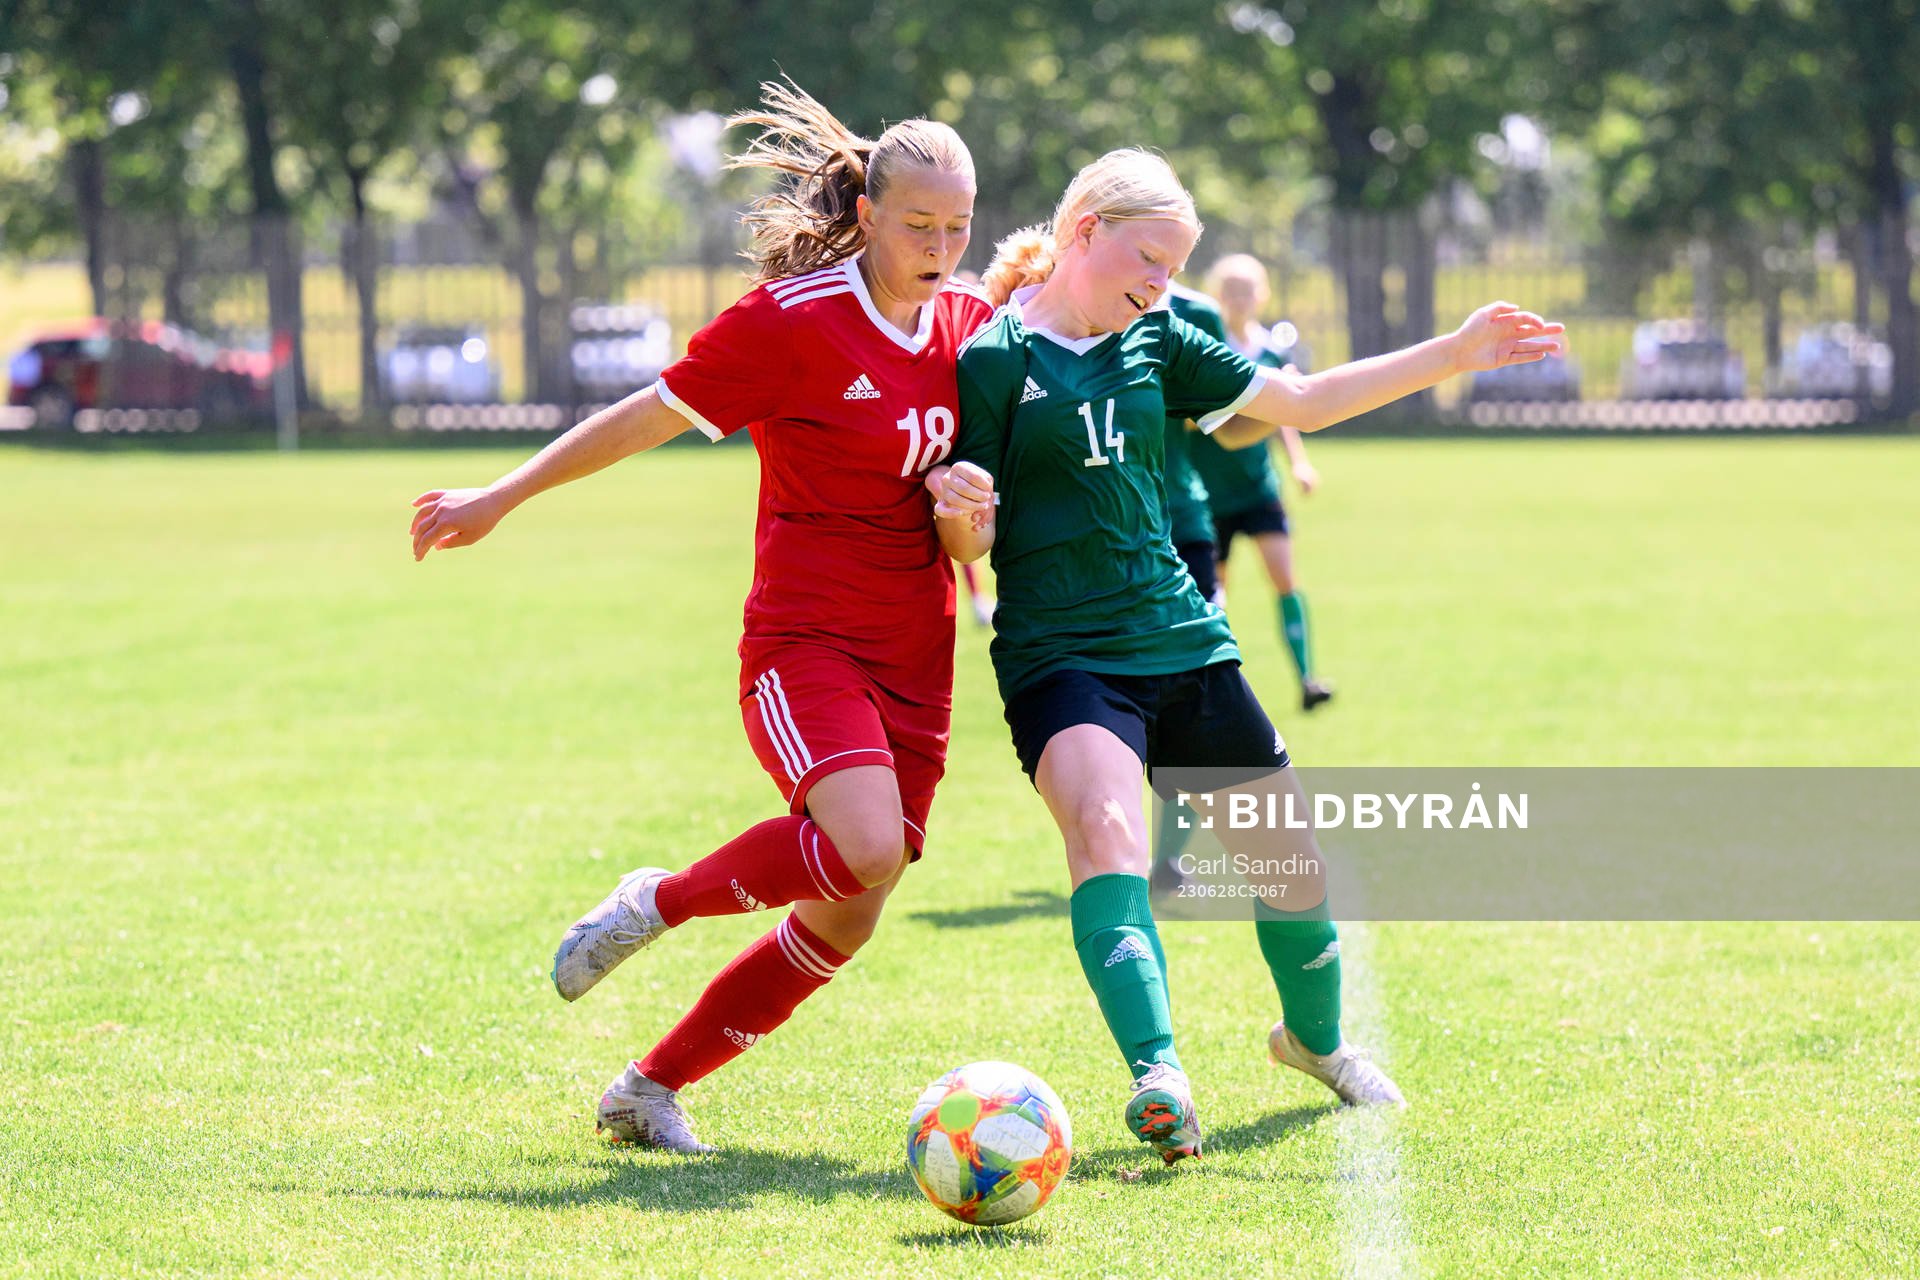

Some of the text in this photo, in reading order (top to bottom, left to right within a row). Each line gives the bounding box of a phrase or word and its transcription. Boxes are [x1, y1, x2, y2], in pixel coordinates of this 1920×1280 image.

[843, 389, 881, 400] adidas
[1019, 389, 1048, 404] didas
[897, 406, 954, 477] 18
[1078, 399, 1125, 467] 14
